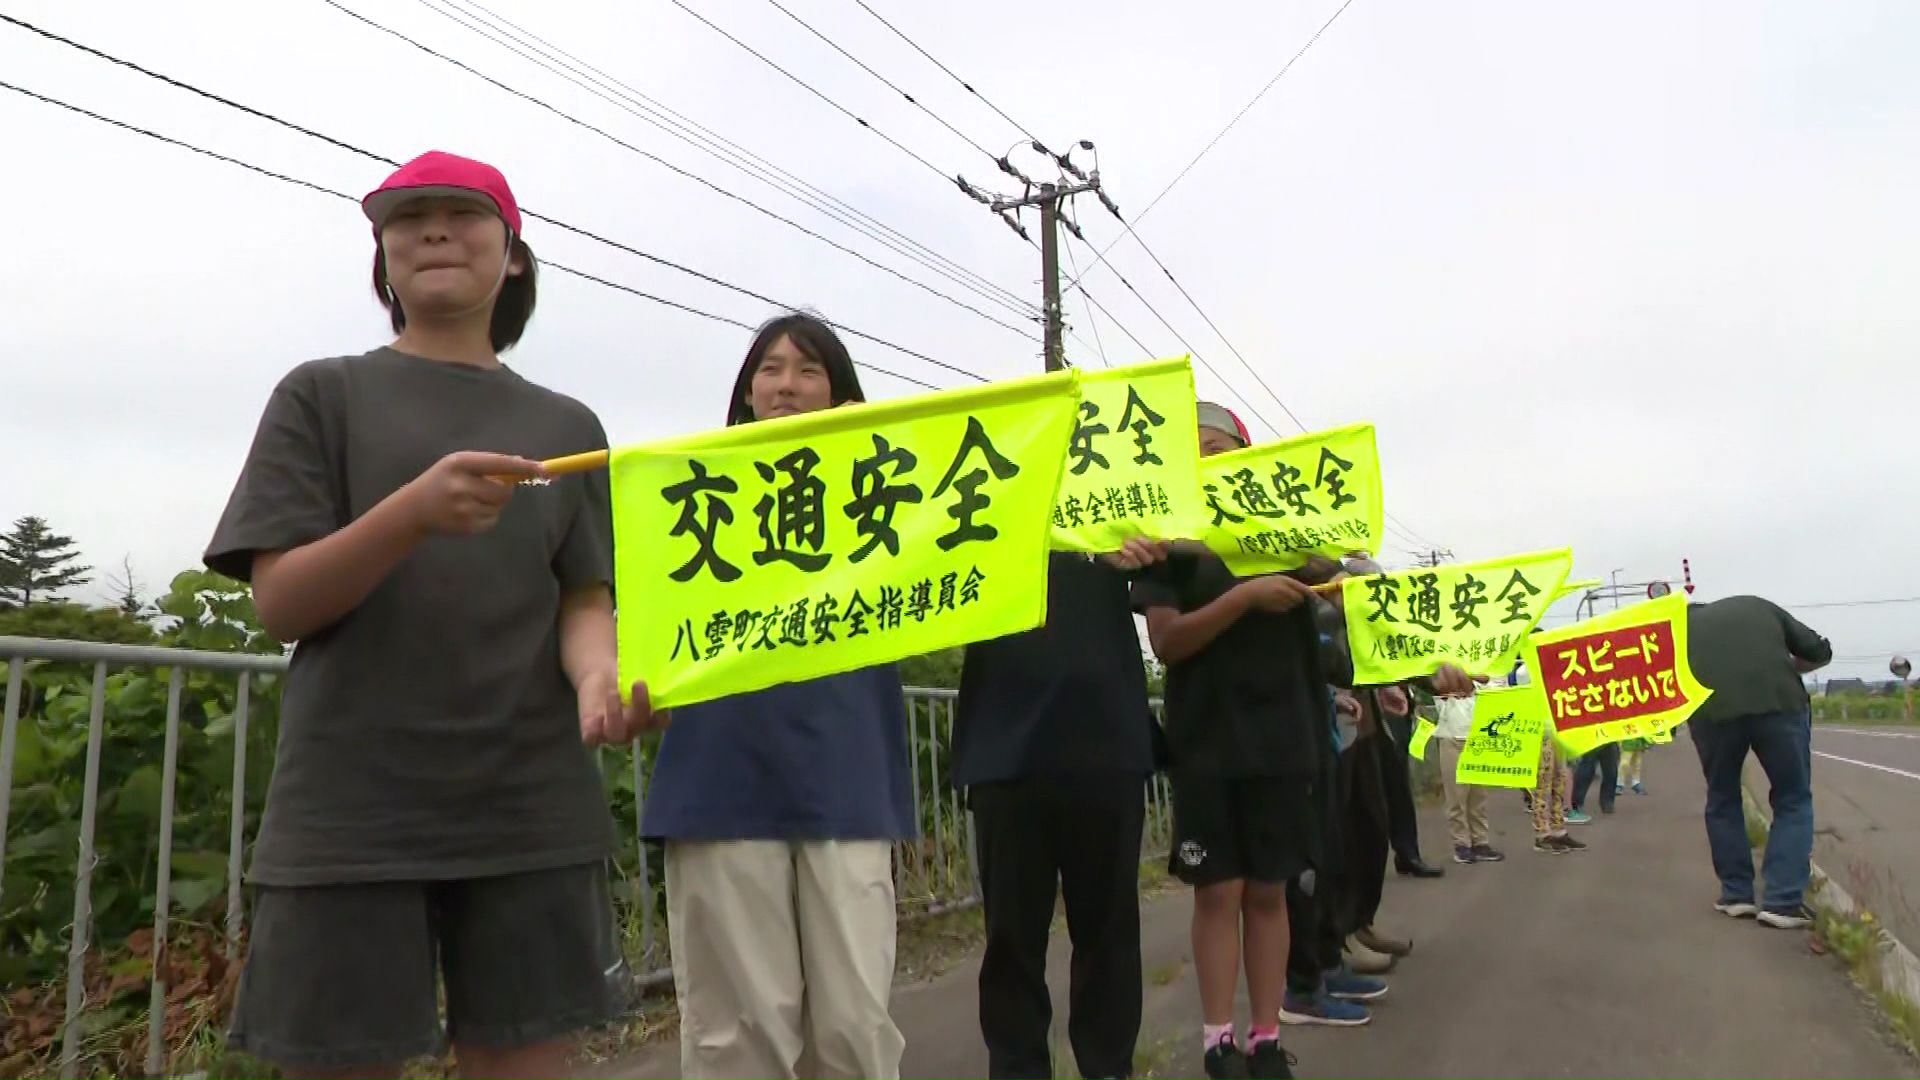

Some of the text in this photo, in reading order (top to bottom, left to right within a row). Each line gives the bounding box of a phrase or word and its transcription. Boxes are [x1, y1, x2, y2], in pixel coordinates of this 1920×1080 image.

[1069, 385, 1165, 475] 安全
[661, 416, 1018, 582] 交通安全
[670, 565, 986, 664] 八雲町交通安全指導員会
[1365, 569, 1541, 632] 交通安全
[1552, 668, 1678, 720] ださないで
[1558, 634, 1660, 680] スピード
